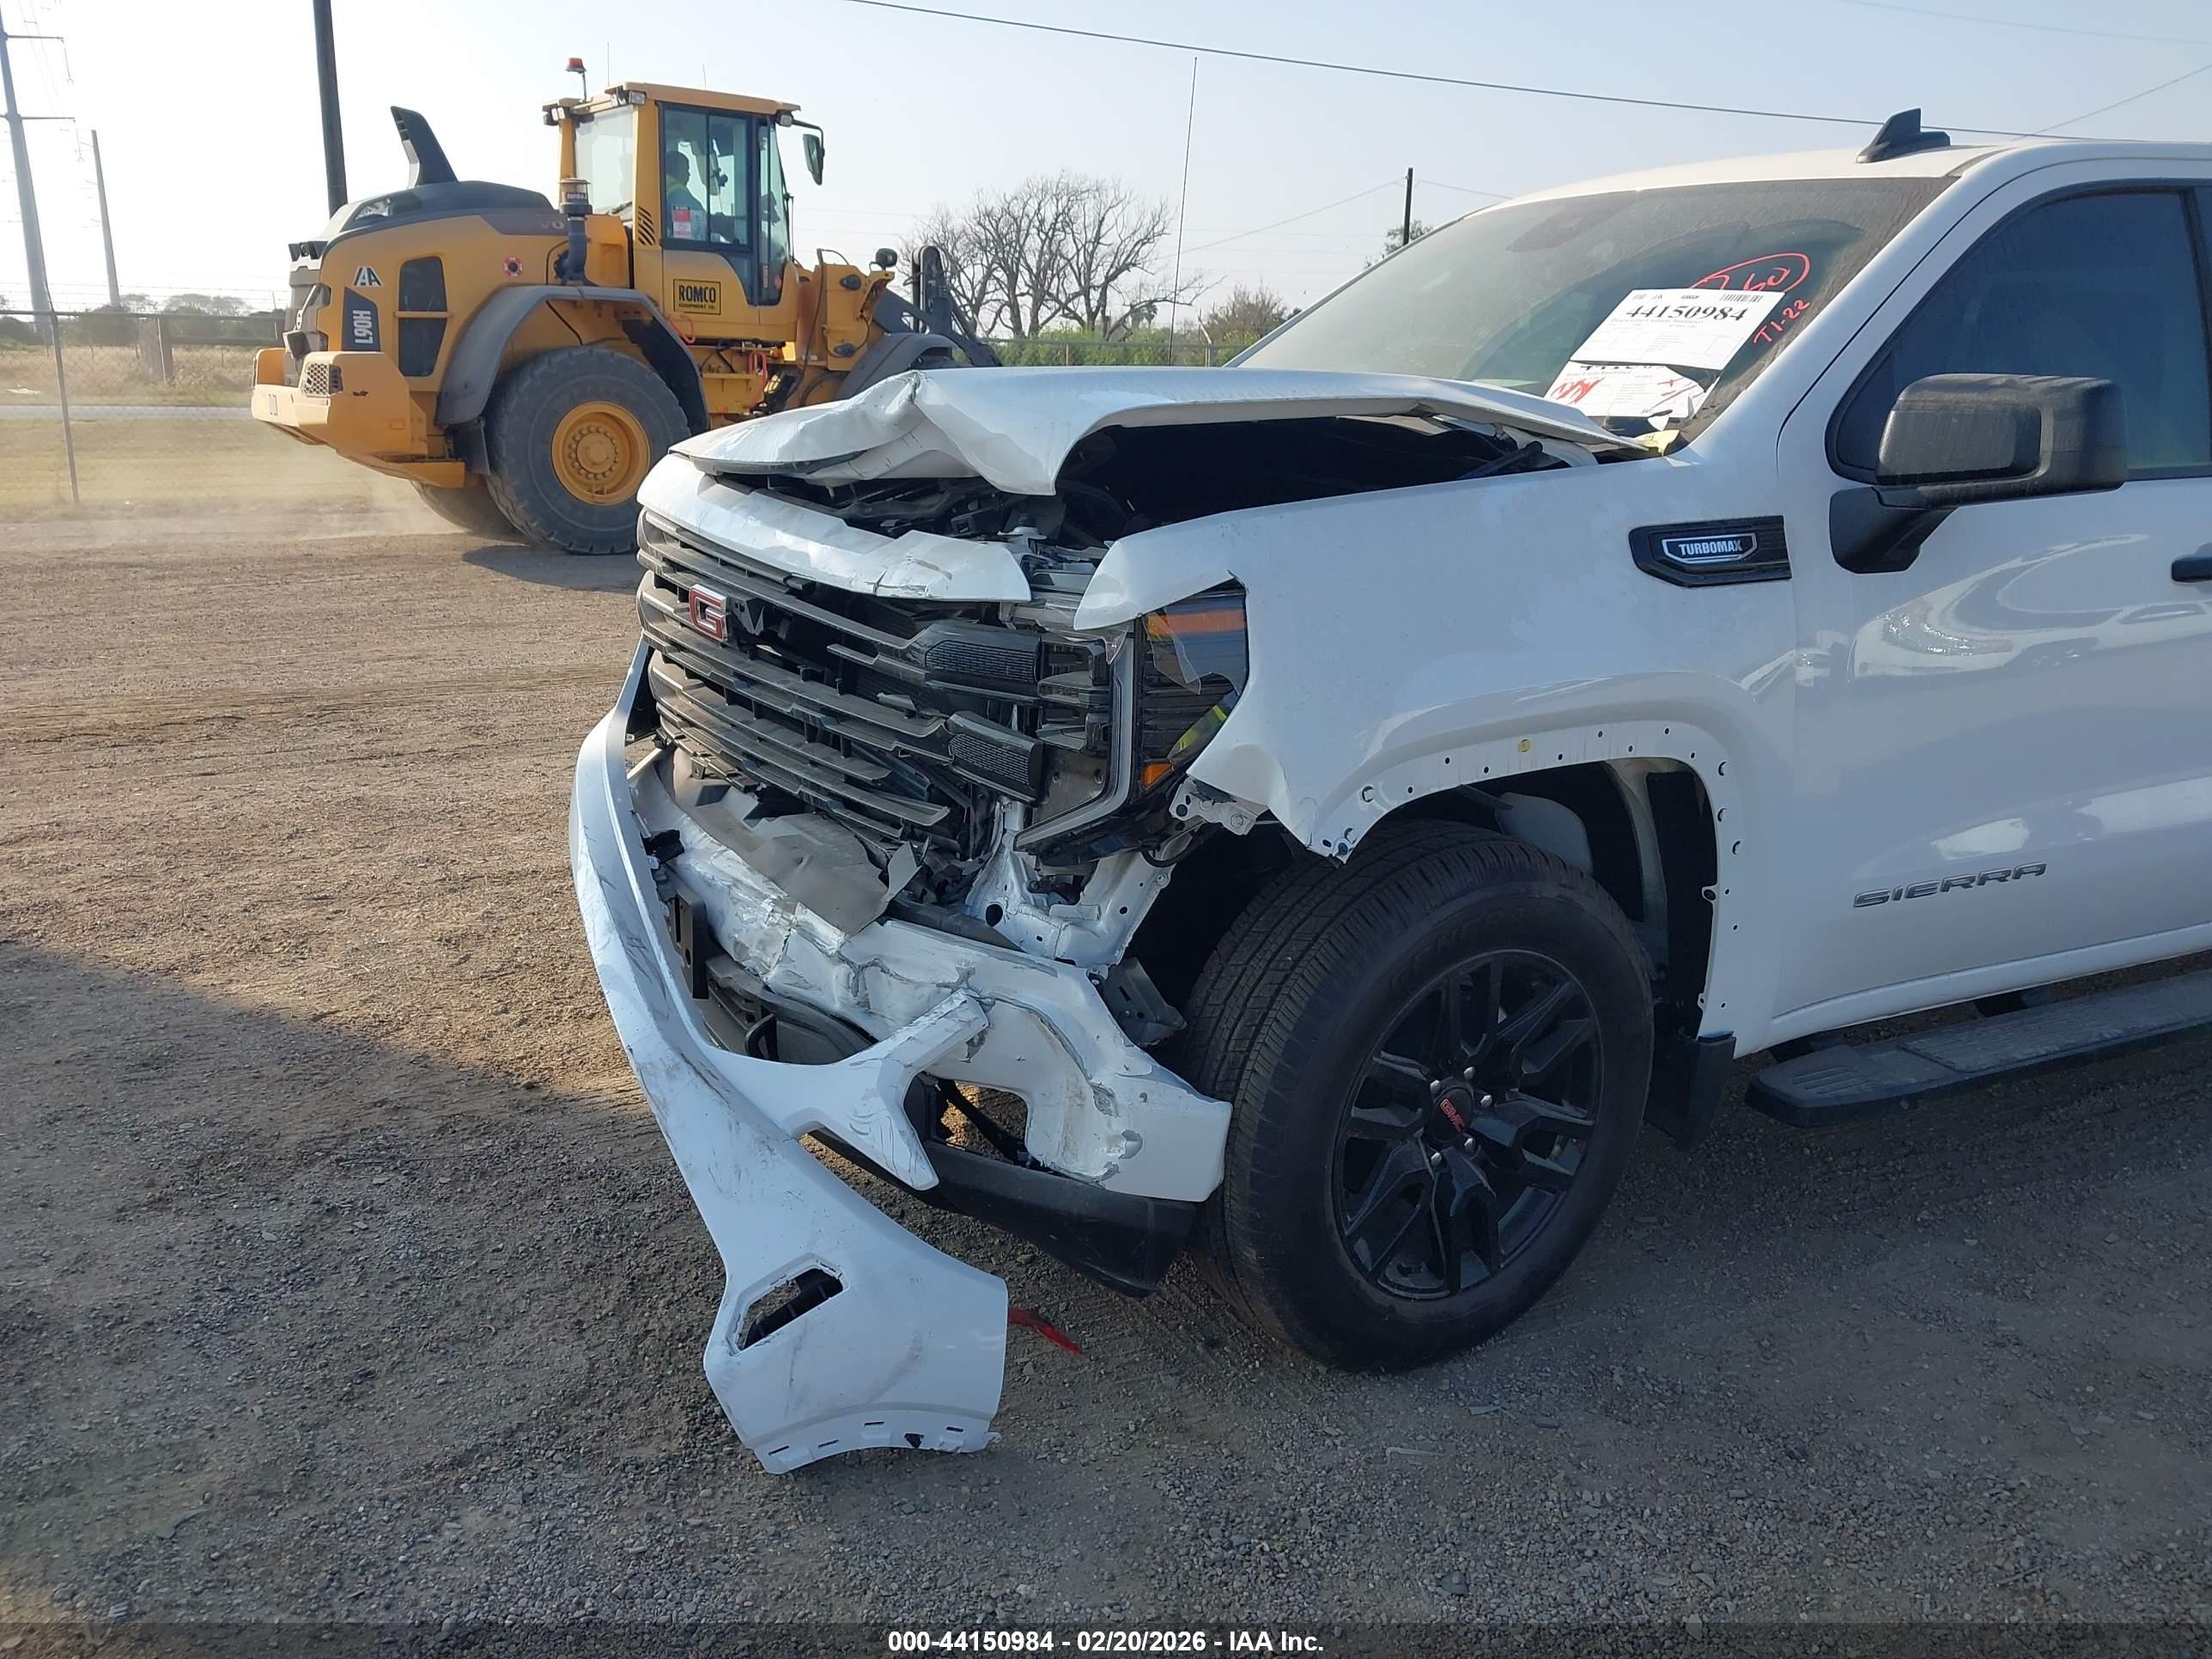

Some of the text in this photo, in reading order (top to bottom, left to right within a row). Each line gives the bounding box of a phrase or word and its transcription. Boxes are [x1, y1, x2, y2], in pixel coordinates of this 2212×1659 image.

[678, 284, 716, 303] ROMCO
[1626, 304, 1748, 321] 44150984
[352, 309, 374, 344] L90H
[1678, 539, 1743, 556] TURBOMAX
[1852, 860, 2048, 908] SIERRA
[1440, 1098, 1466, 1133] GMC
